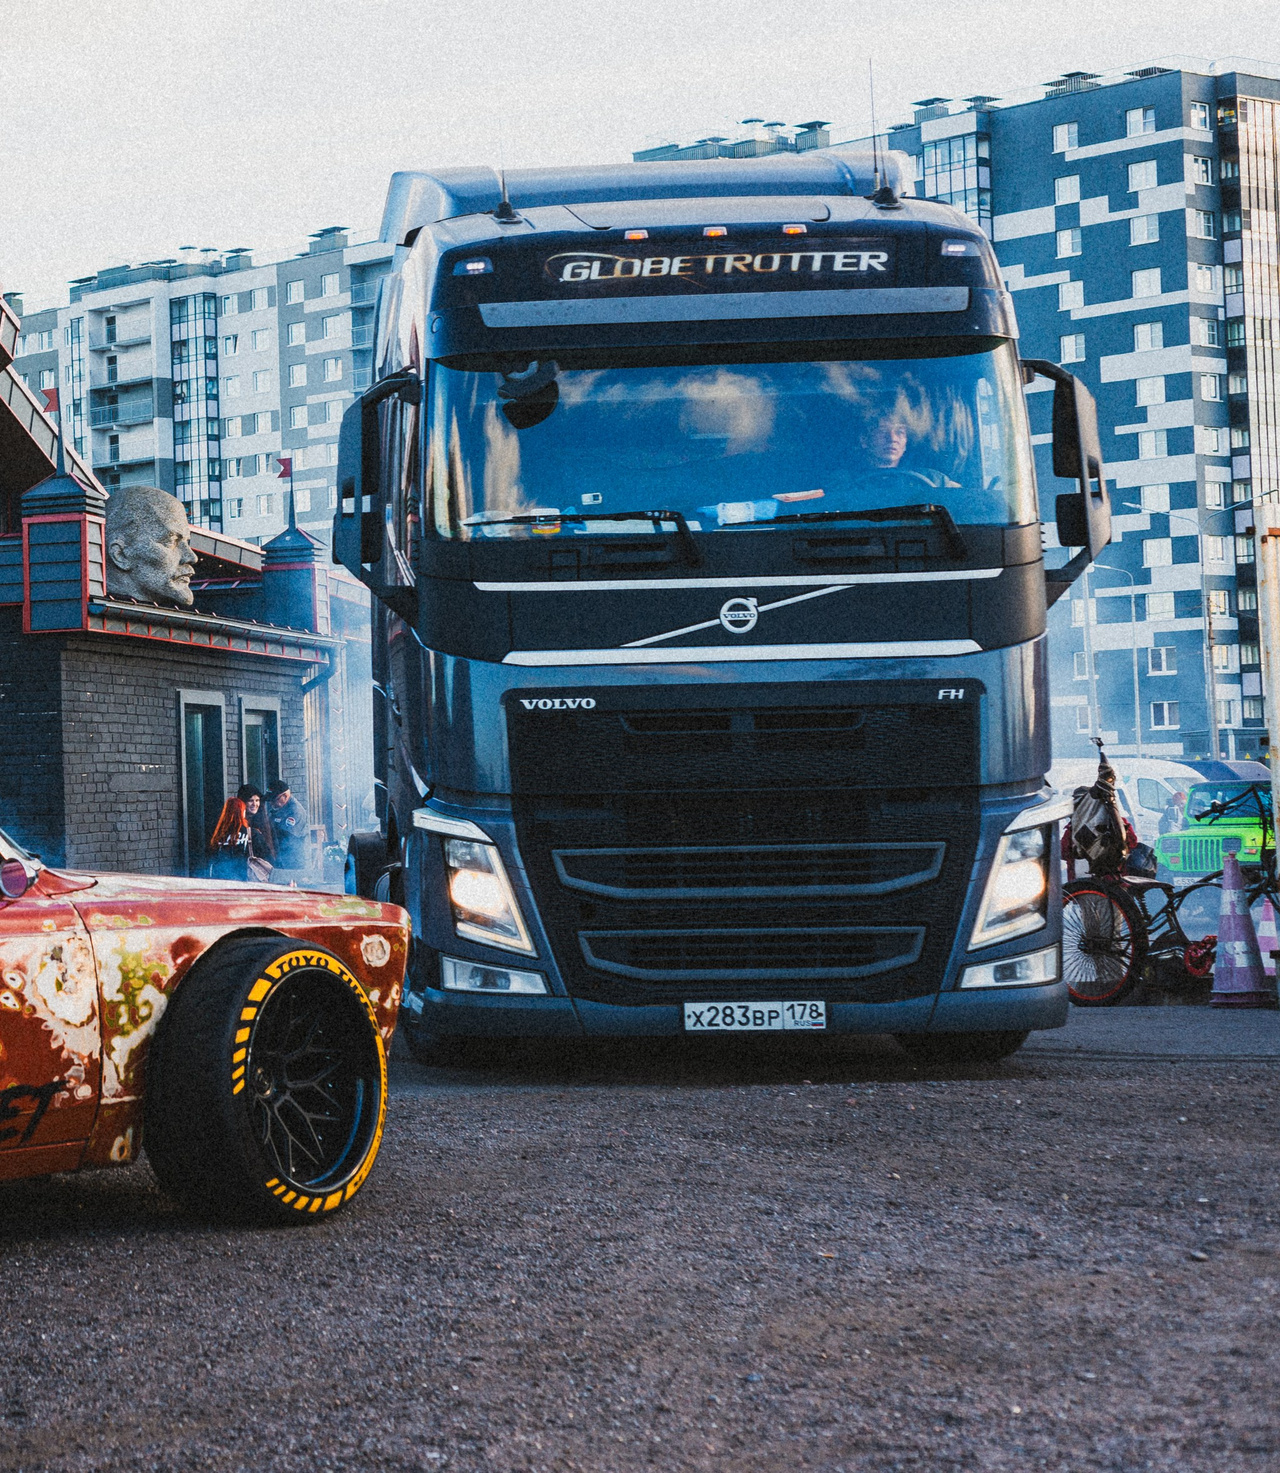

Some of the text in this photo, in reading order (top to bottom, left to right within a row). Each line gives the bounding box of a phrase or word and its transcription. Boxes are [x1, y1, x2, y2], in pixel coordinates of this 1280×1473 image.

[561, 251, 889, 282] GLOBETROTTER
[937, 688, 965, 700] FH
[519, 698, 597, 710] VOLVO
[276, 954, 330, 976] TOYO
[786, 1003, 820, 1020] 178
